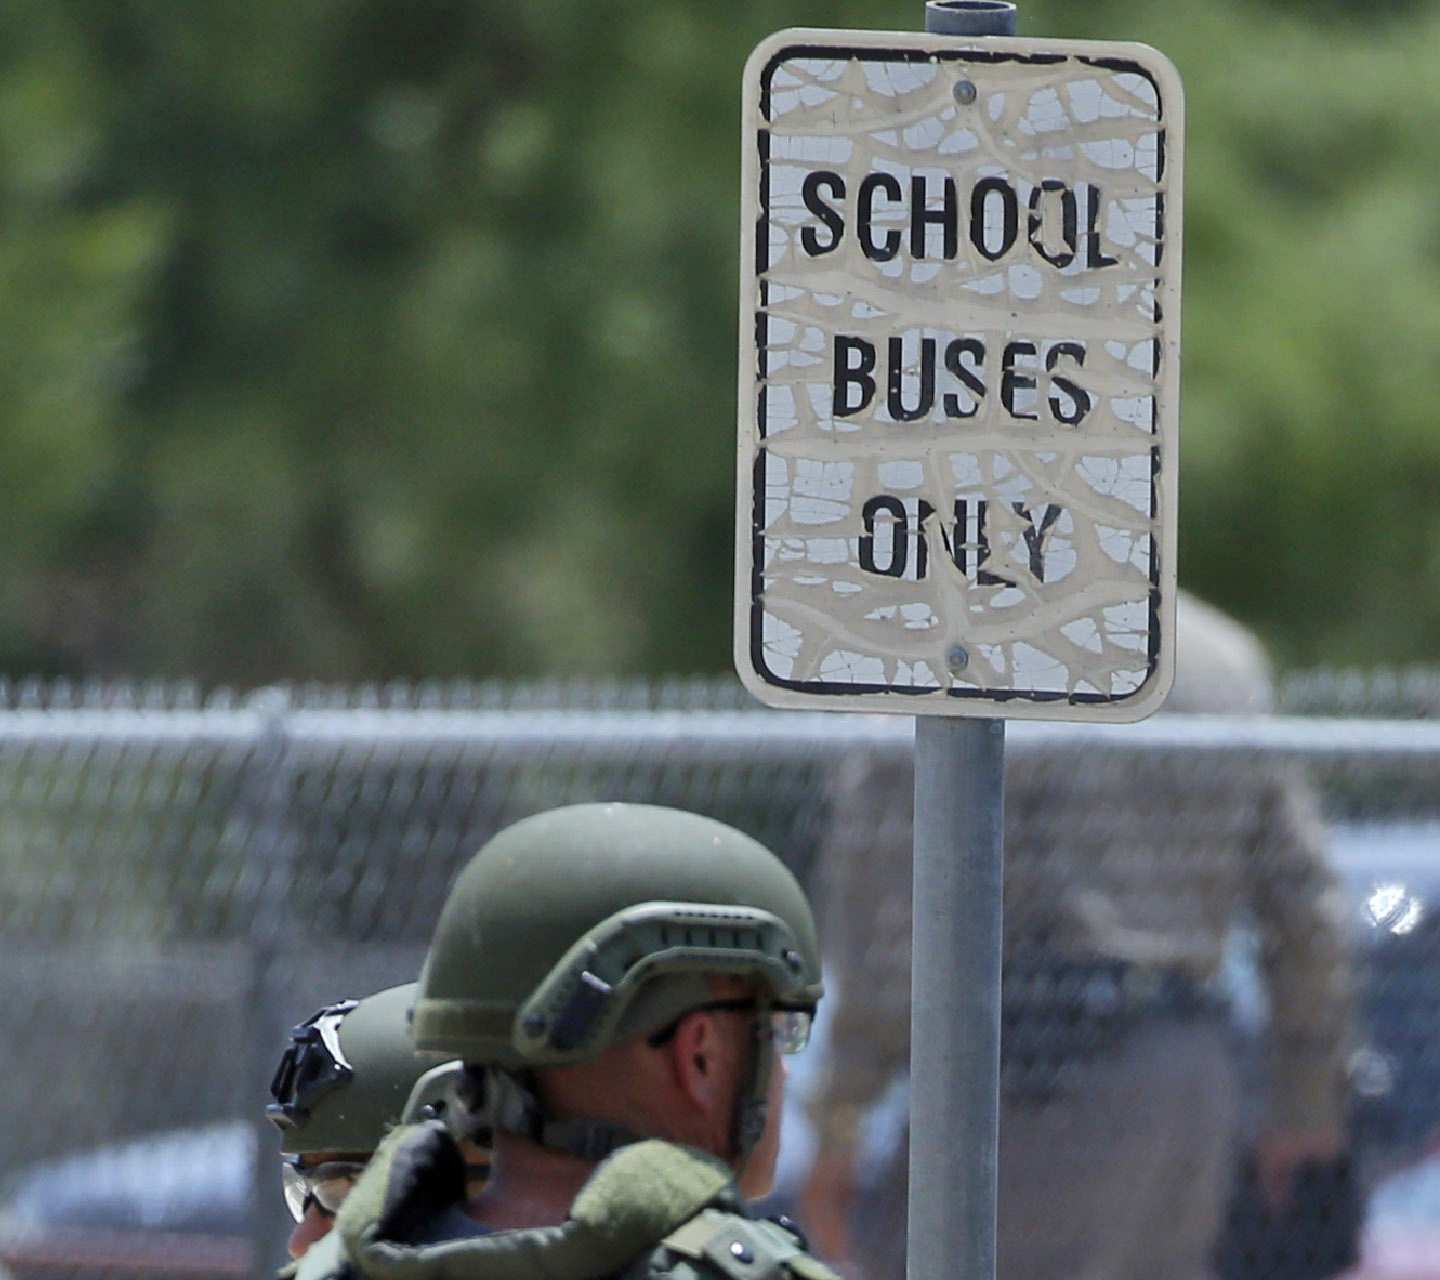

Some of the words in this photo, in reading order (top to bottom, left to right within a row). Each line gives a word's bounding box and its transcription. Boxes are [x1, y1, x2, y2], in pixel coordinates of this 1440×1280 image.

[800, 171, 1119, 270] SCHOOL
[833, 335, 1092, 426] BUSES
[858, 494, 1062, 588] ONLY
